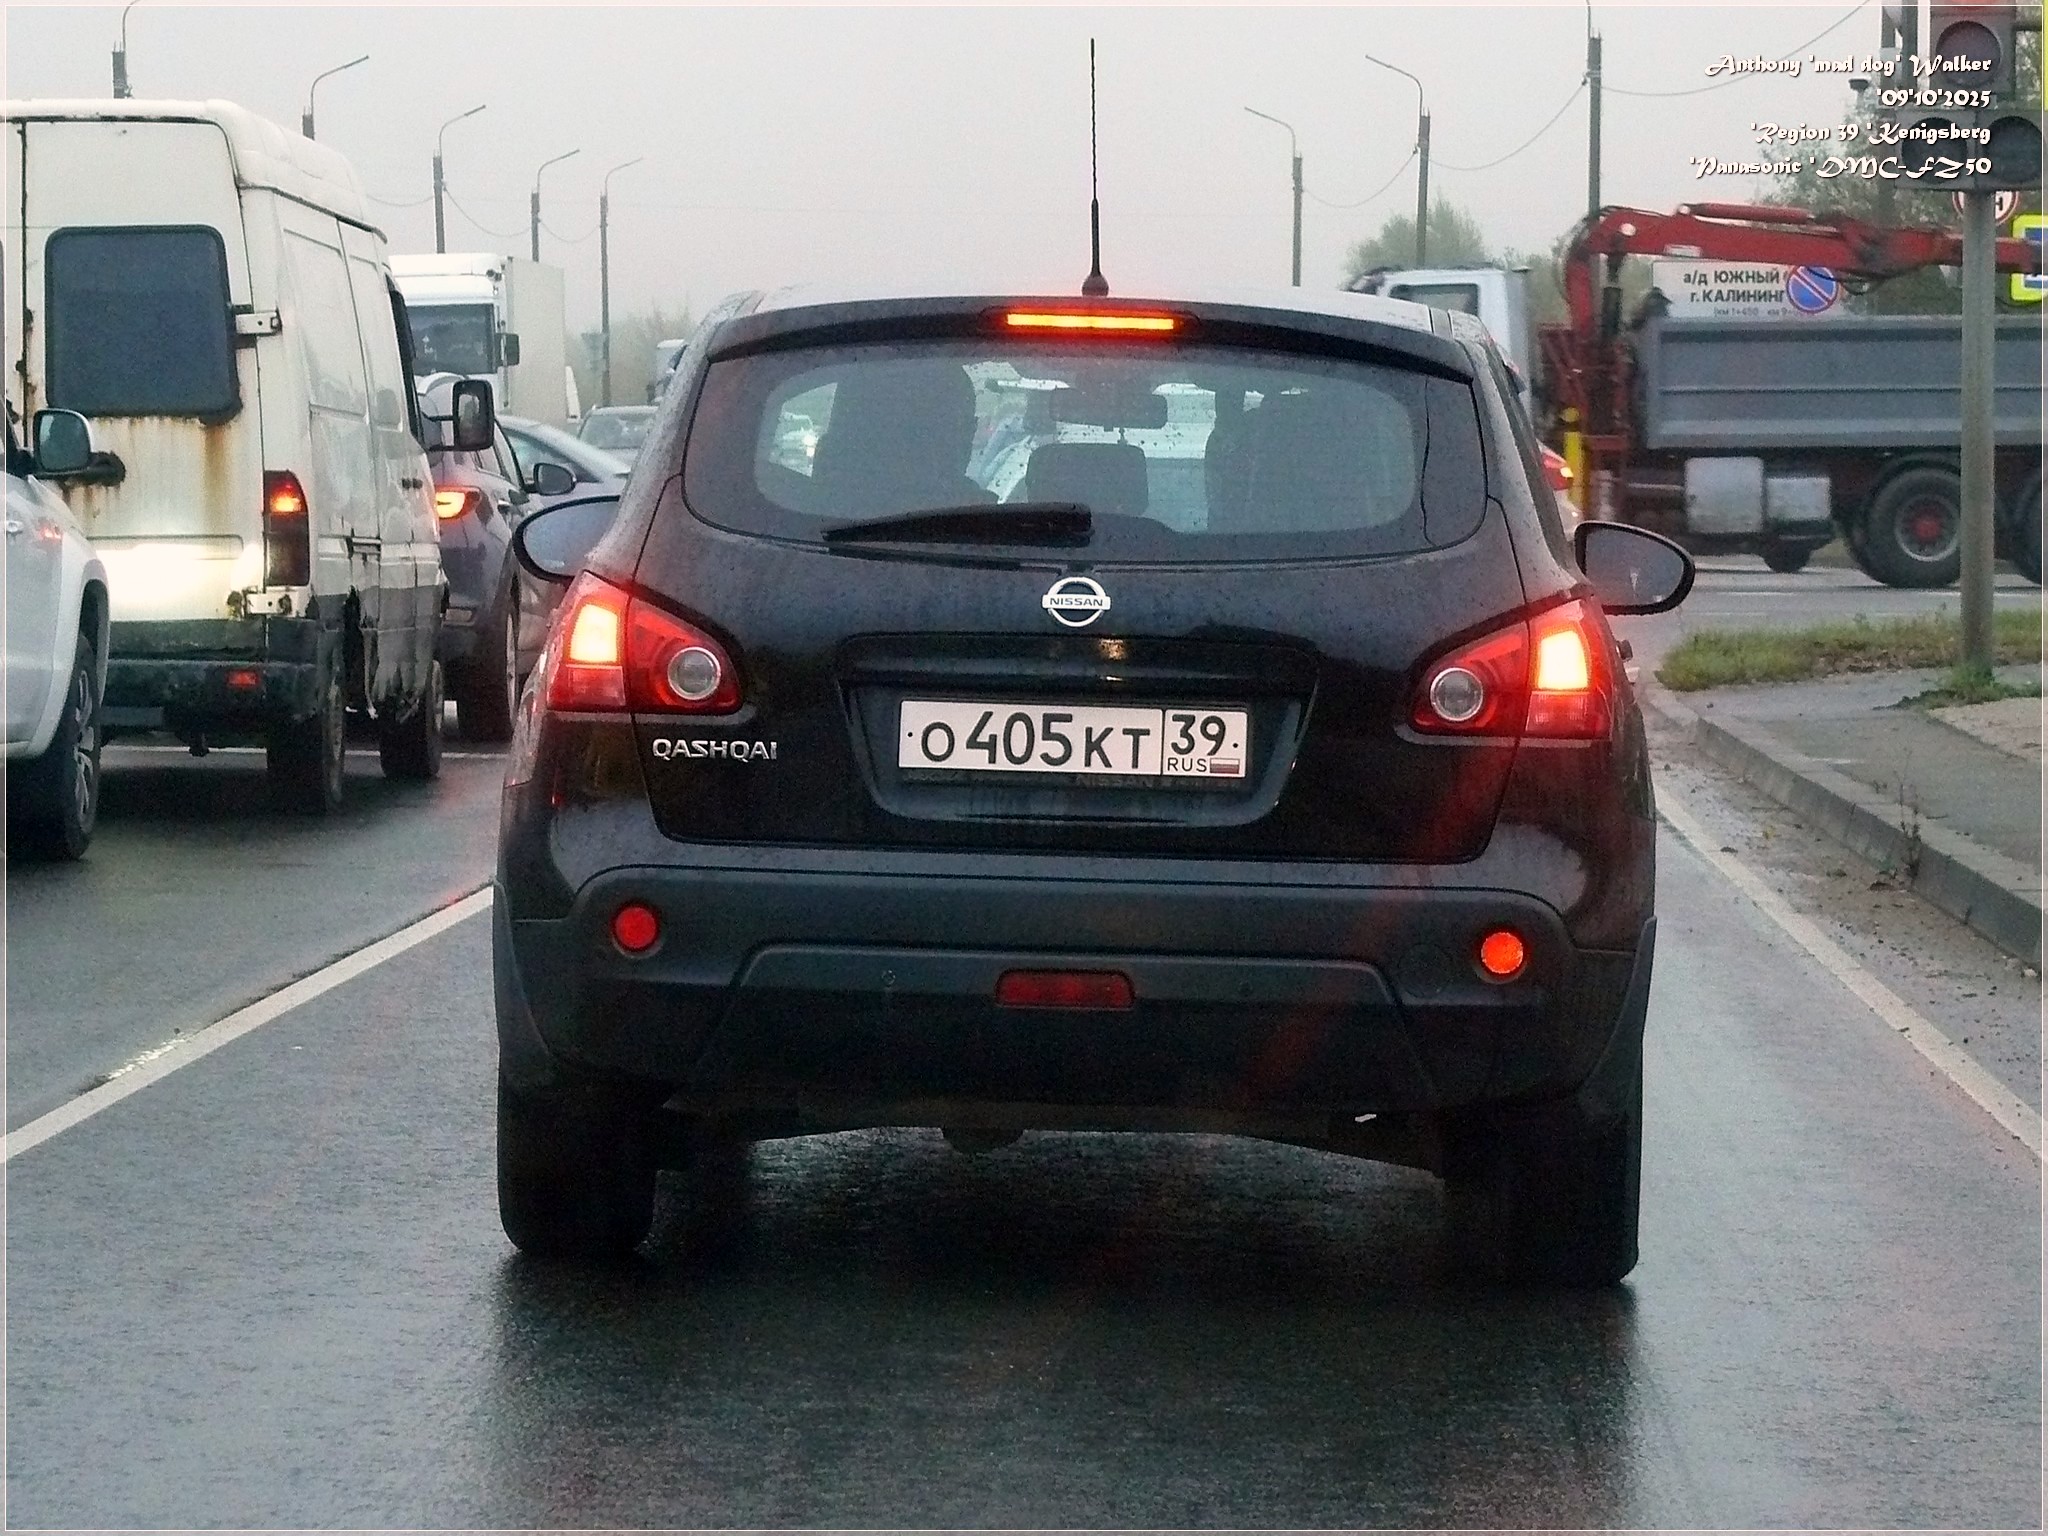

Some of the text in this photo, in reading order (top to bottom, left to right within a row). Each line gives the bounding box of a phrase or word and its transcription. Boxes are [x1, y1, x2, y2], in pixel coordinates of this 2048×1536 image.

[1683, 270, 1708, 286] а/д
[1714, 267, 1780, 284] ЮЖНЫЙ
[1049, 597, 1104, 607] NISSAN
[1170, 713, 1227, 756] 39
[652, 738, 777, 763] QASHQAI
[1167, 757, 1207, 773] RUS
